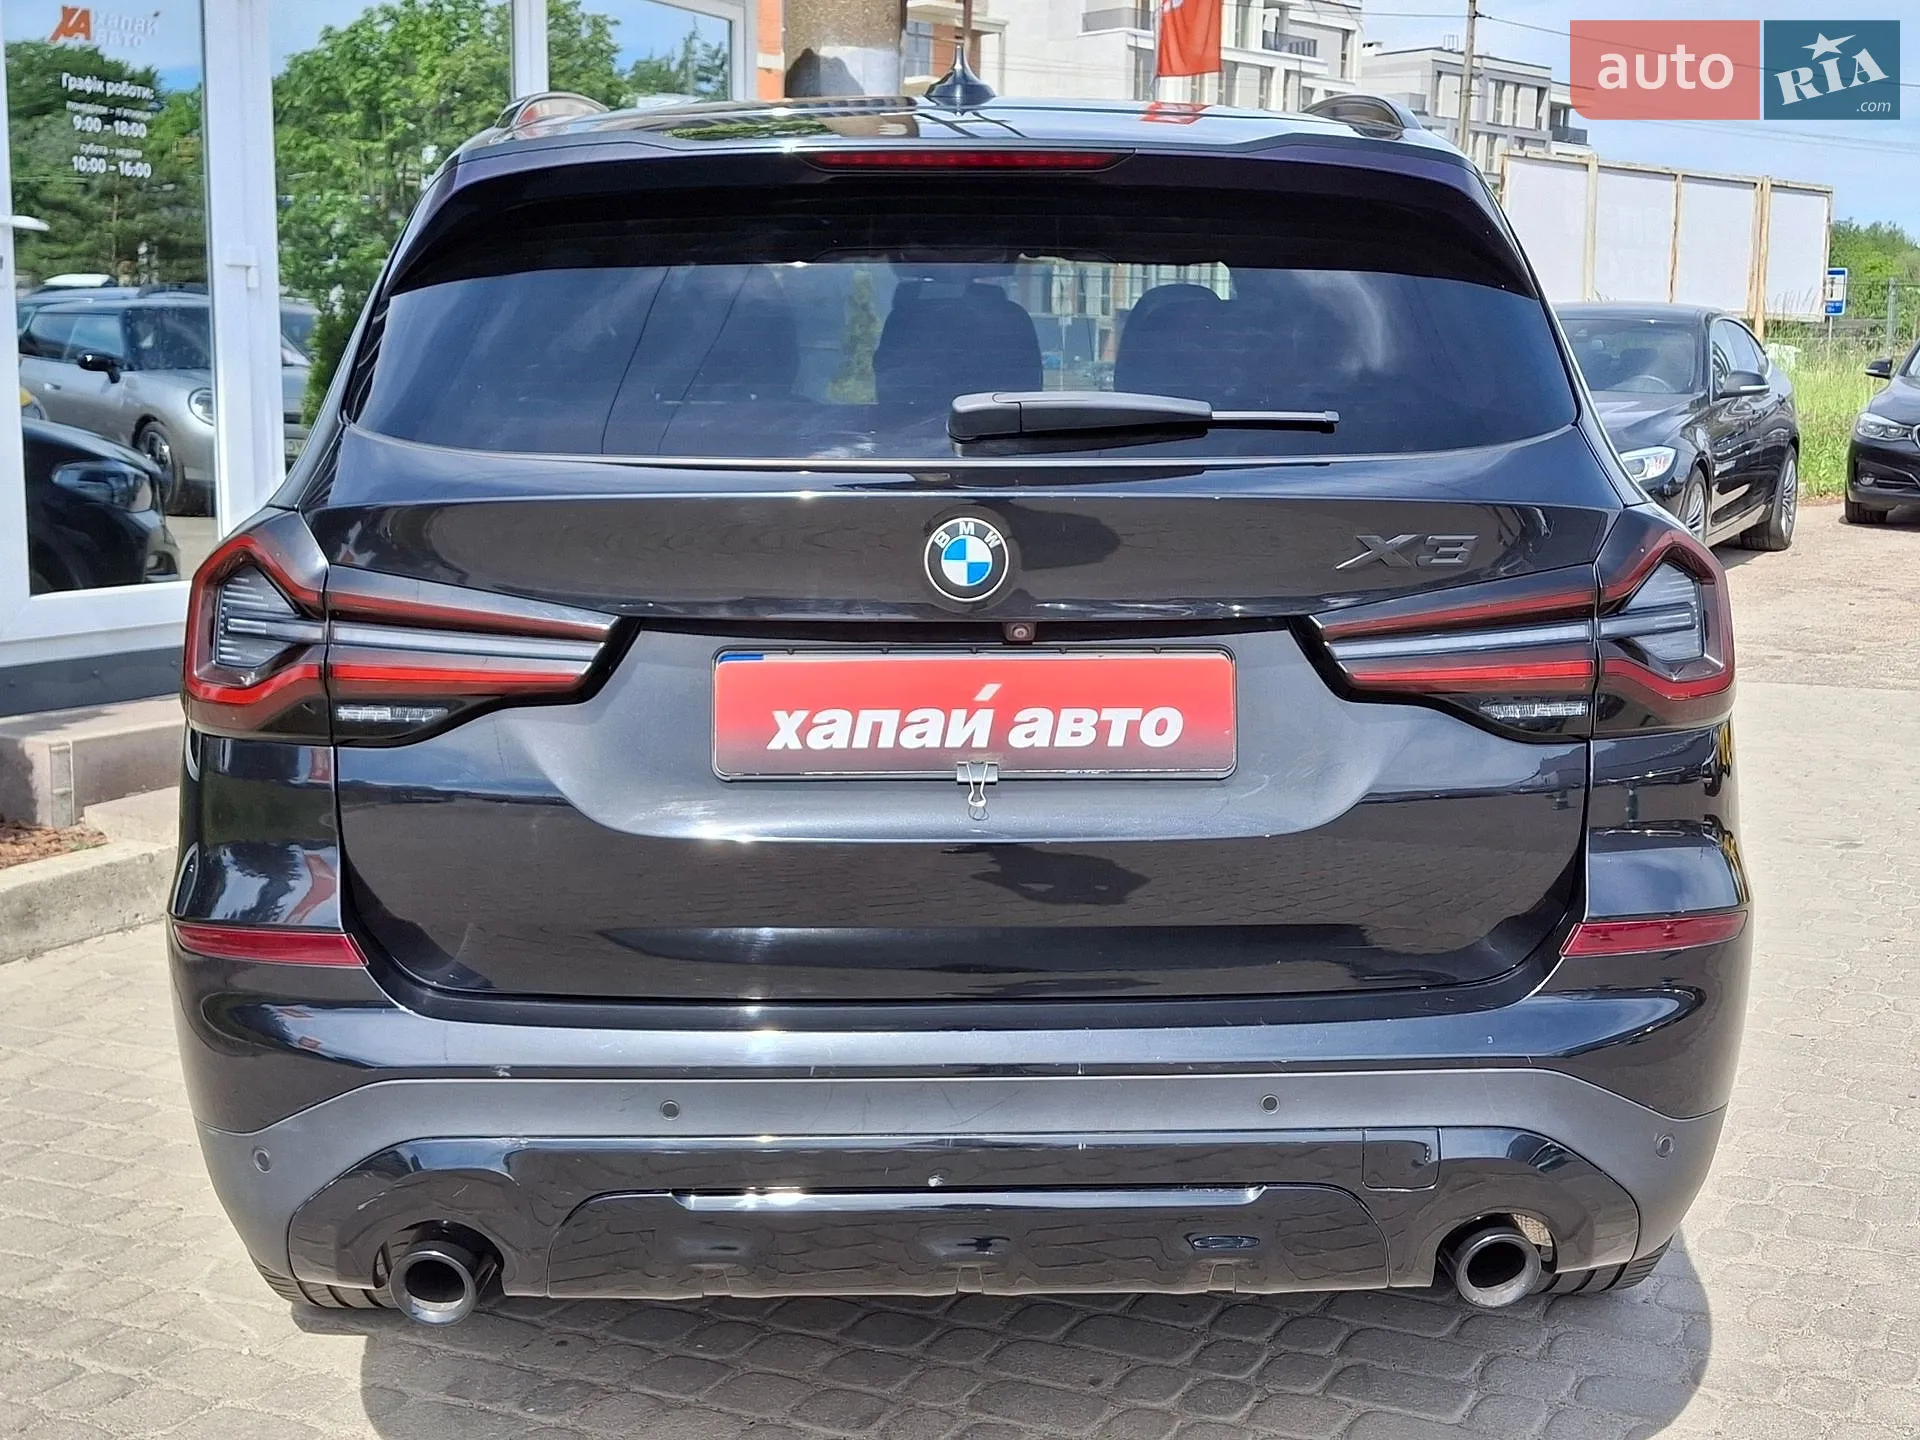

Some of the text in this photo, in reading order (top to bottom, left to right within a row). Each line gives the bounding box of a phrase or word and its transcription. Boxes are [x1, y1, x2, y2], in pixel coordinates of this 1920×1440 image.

[61, 72, 154, 99] Графік роботи:
[72, 115, 102, 133] 9:00
[72, 155, 106, 174] 10:00
[118, 161, 152, 179] 16:00
[934, 521, 1001, 549] BMW
[1334, 534, 1479, 570] X3
[766, 683, 1184, 750] хапай авто
